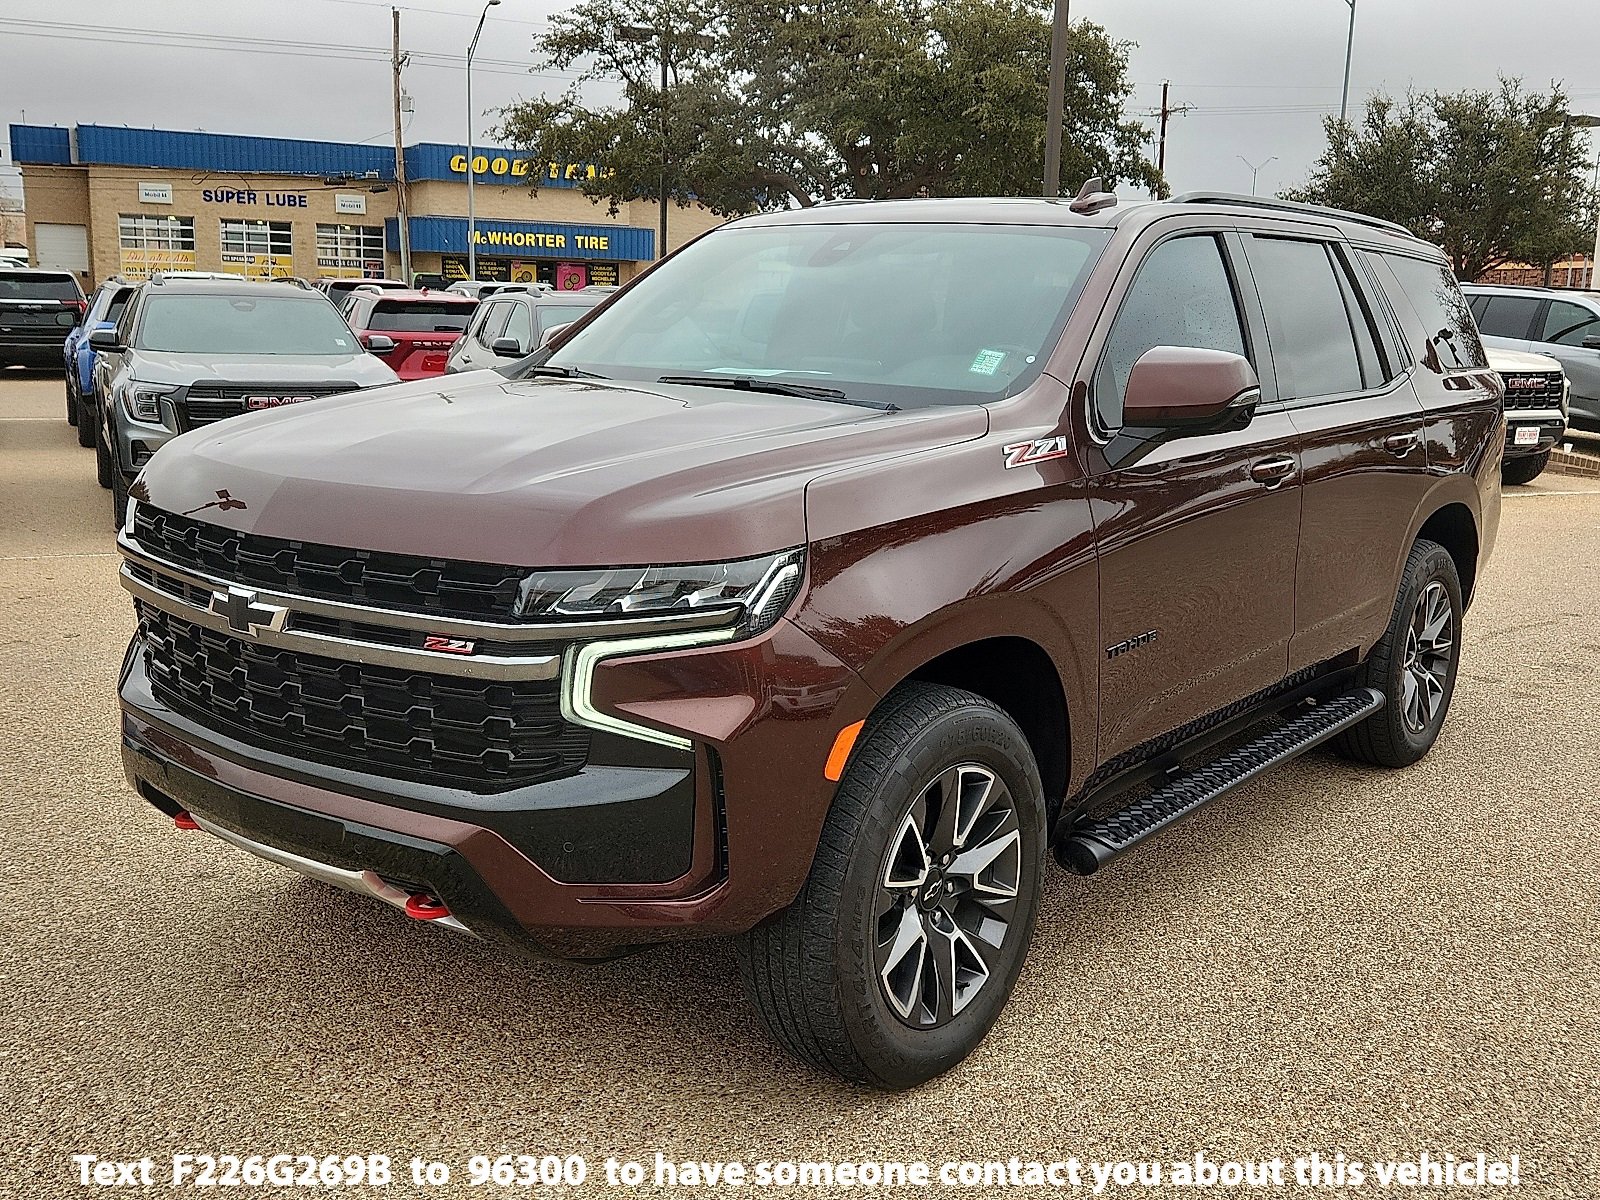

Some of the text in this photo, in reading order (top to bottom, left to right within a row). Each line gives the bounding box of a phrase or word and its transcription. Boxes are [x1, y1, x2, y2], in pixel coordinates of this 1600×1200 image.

[202, 189, 308, 208] SUPER LUBE
[574, 235, 609, 250] TIRE
[346, 260, 360, 268] CARE
[1508, 378, 1546, 389] GMC
[1002, 435, 1068, 469] Z71
[424, 636, 475, 654] Z71
[1105, 629, 1157, 660] TAHOE
